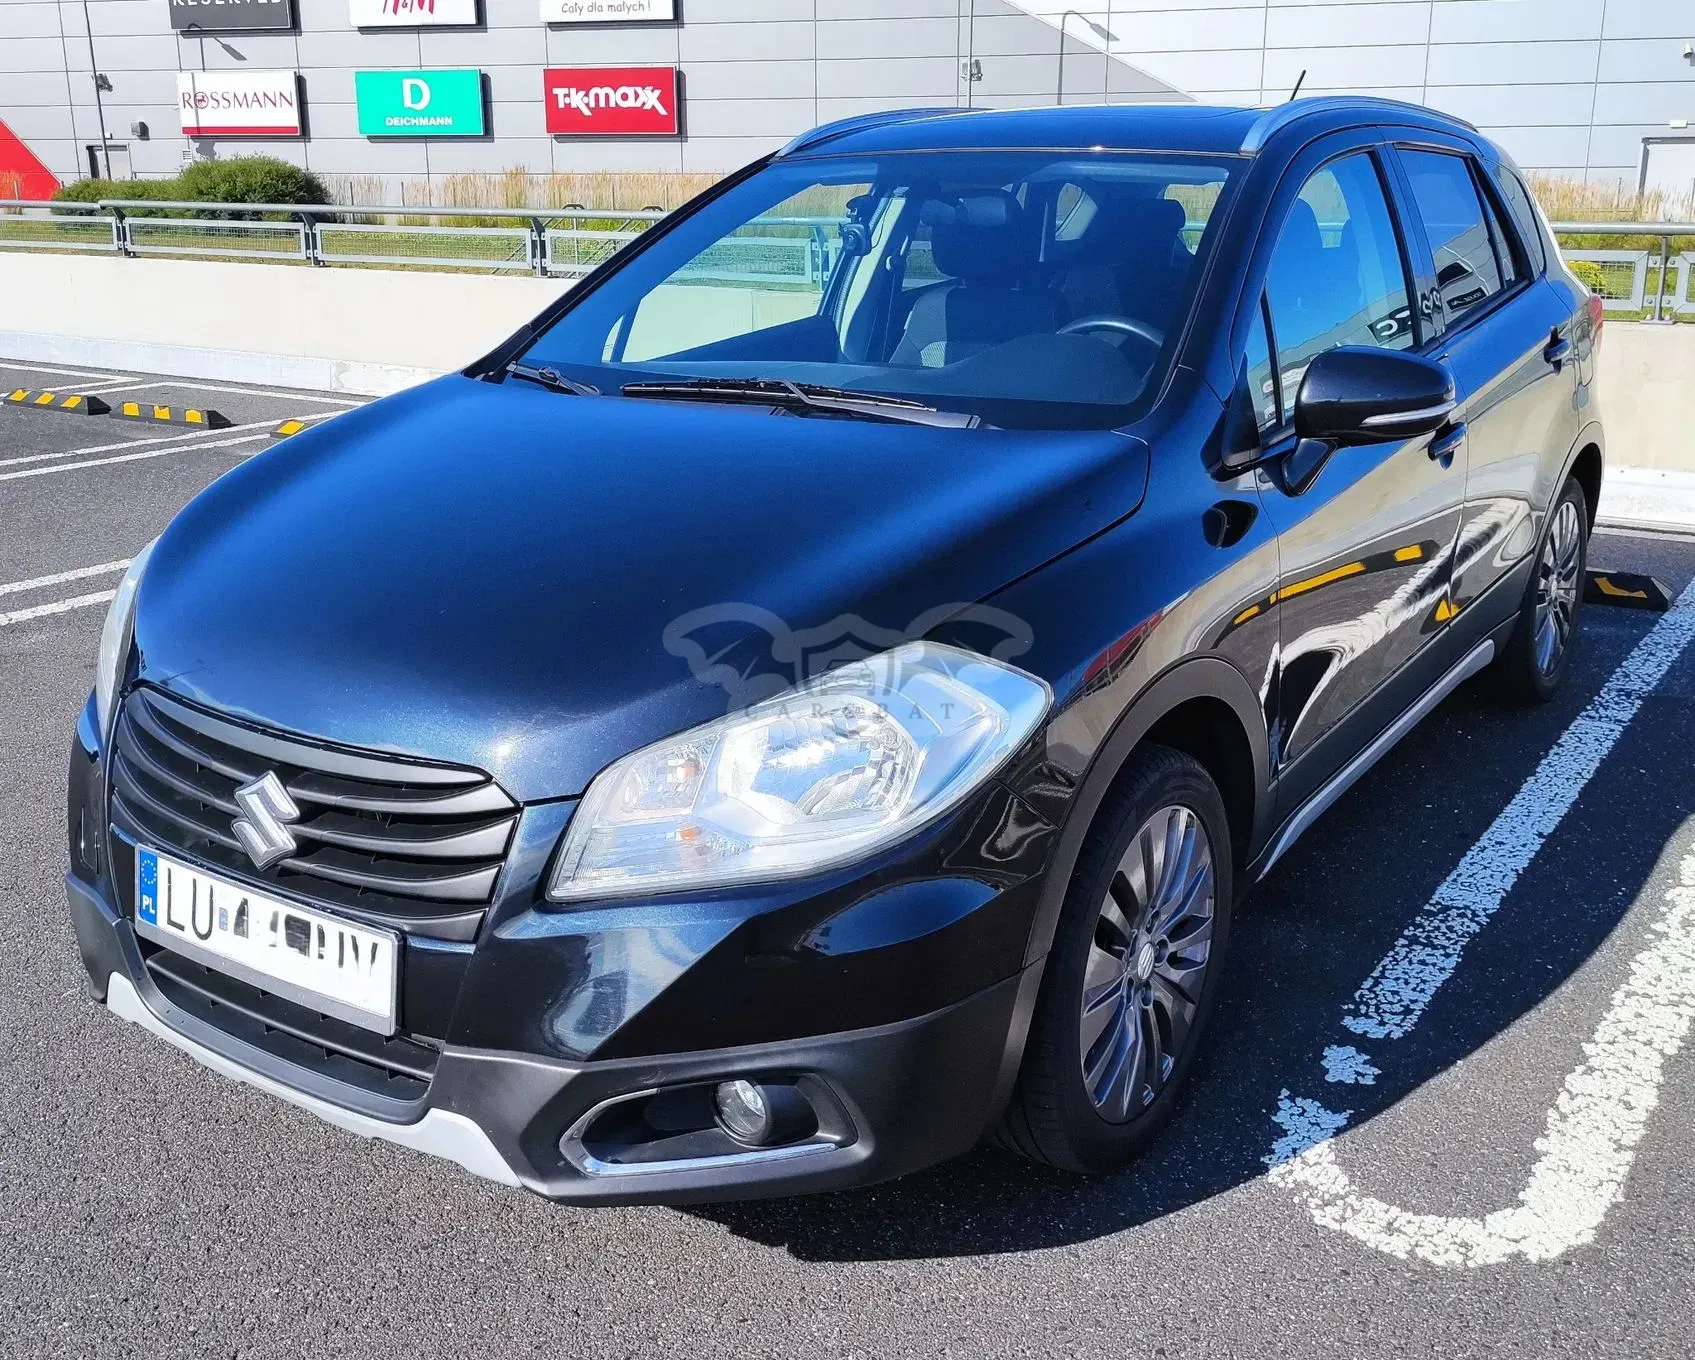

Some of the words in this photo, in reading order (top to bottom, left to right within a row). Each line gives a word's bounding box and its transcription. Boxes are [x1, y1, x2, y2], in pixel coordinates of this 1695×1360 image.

[587, 1, 603, 13] dla
[182, 90, 294, 110] ROSSMANN
[402, 78, 431, 111] D
[385, 116, 453, 127] DEICHMANN
[142, 894, 156, 915] PL
